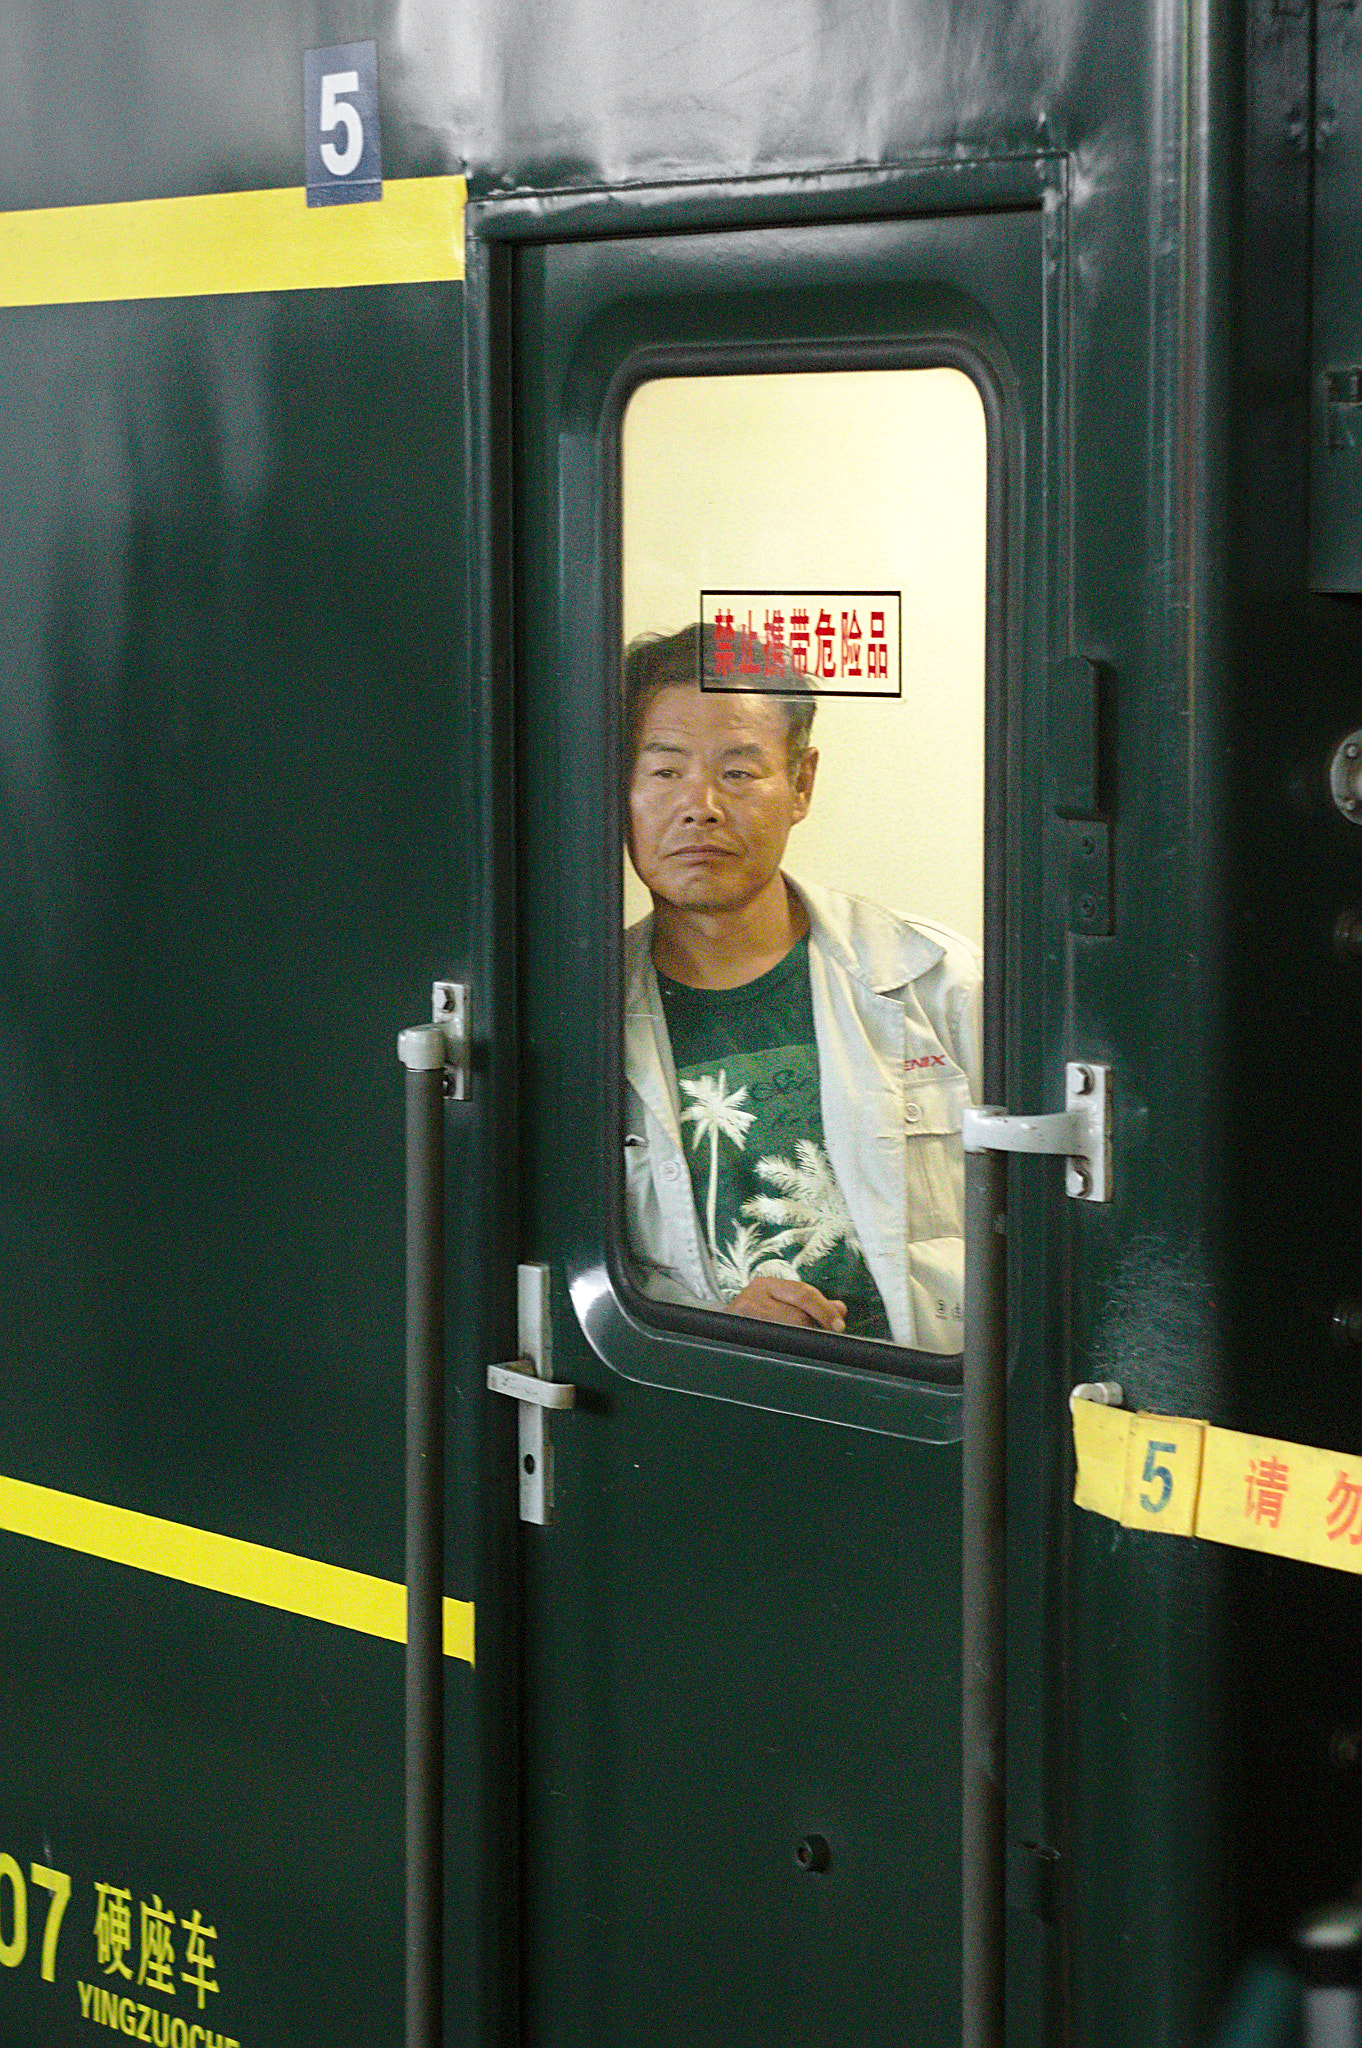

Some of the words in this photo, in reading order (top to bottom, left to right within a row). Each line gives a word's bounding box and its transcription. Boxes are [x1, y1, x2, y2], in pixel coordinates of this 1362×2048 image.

[320, 71, 364, 176] 5
[713, 608, 888, 679] 禁止携带危险品
[1139, 1440, 1177, 1514] 5
[0, 1852, 72, 1983] 07
[93, 1881, 220, 2010] 硬座车
